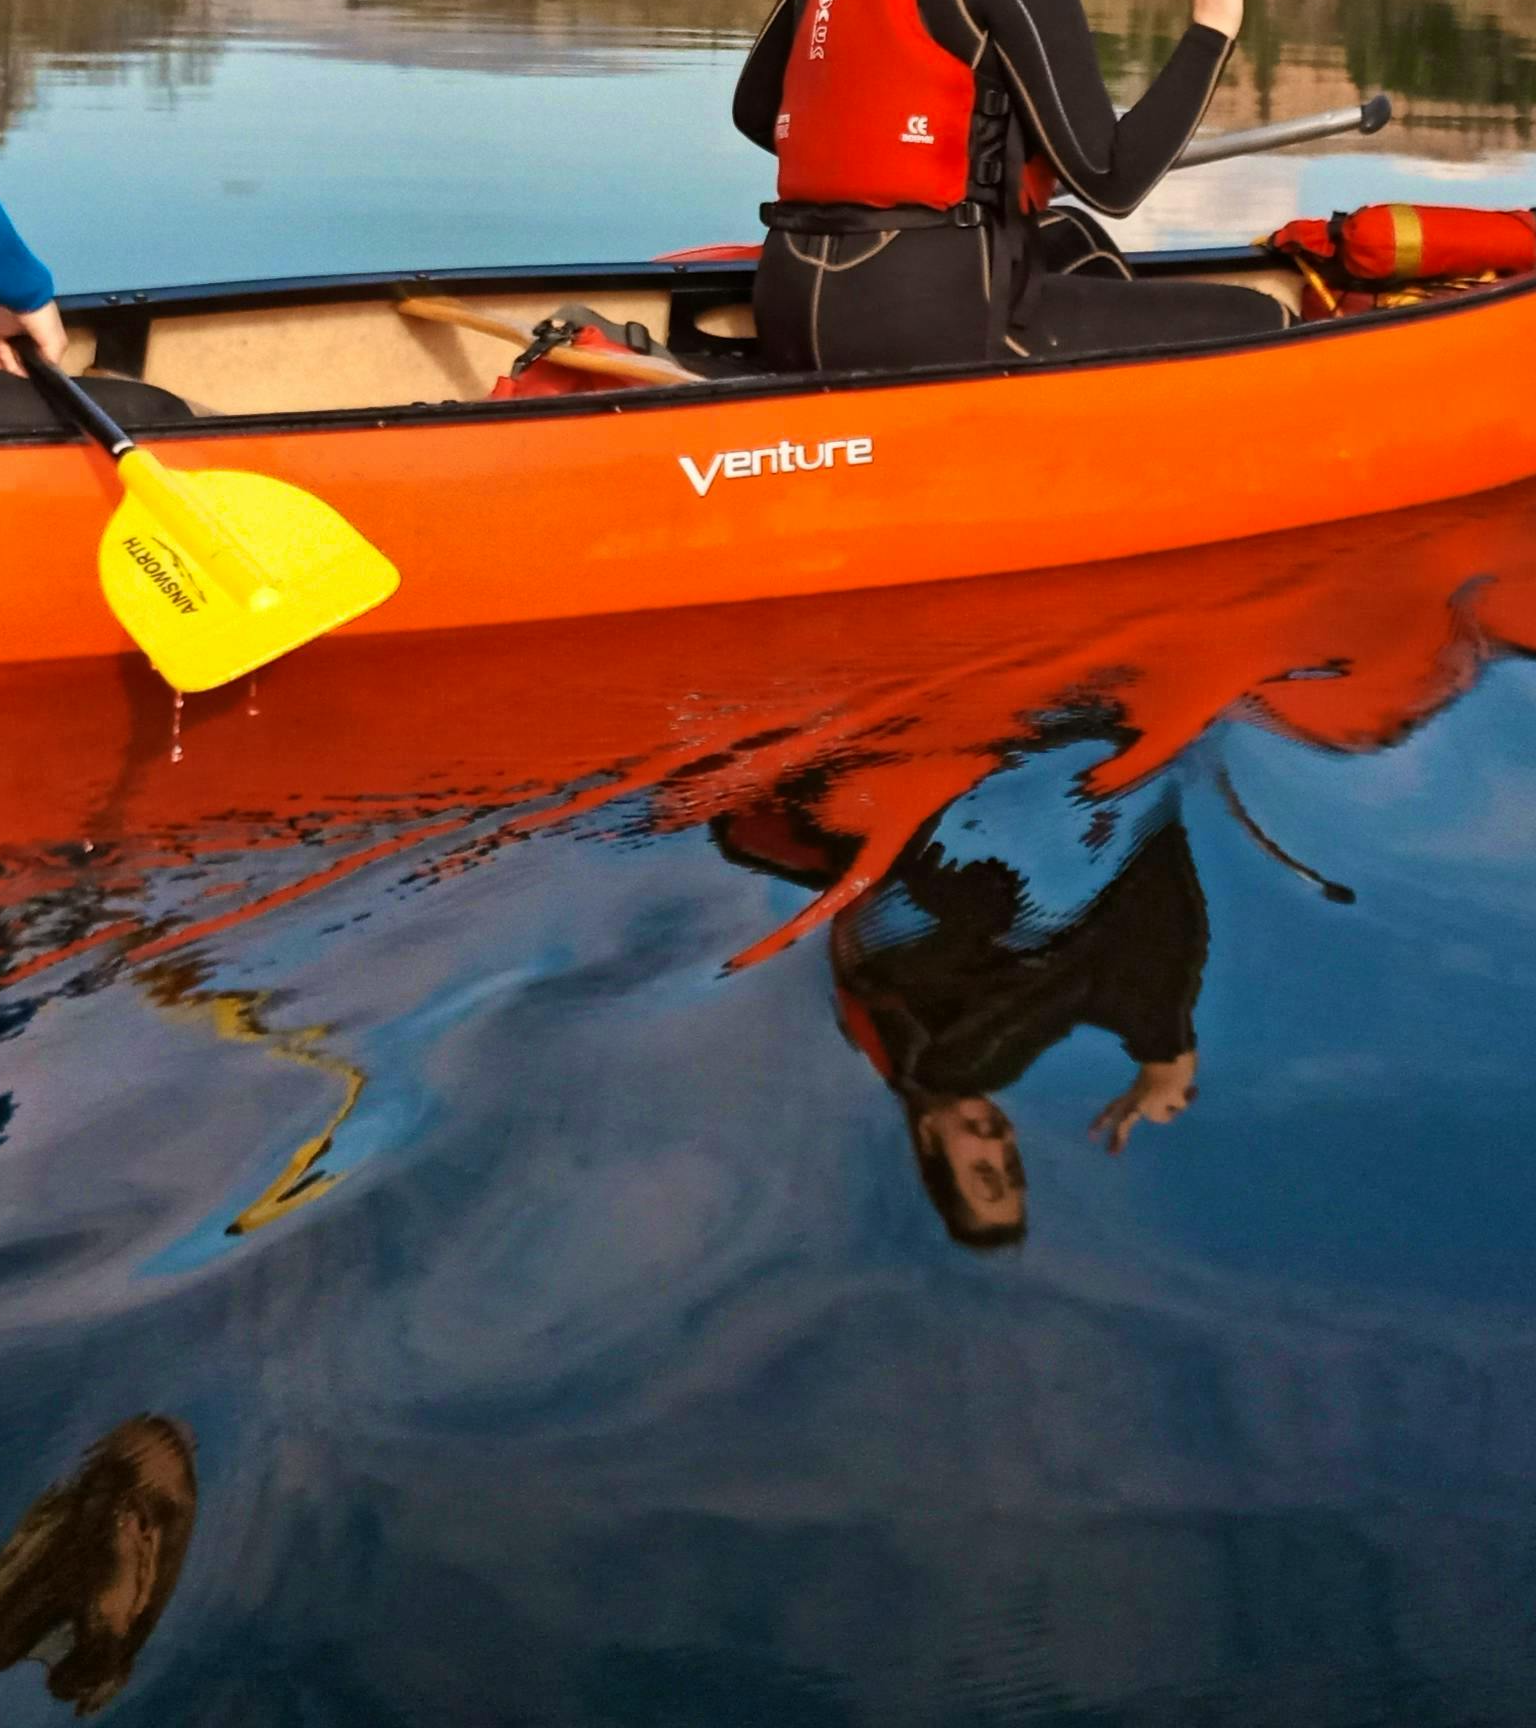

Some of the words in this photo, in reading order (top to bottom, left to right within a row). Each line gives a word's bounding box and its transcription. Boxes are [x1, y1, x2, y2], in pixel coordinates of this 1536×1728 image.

[907, 115, 929, 136] CE
[677, 437, 874, 498] Venture
[122, 536, 199, 615] AINSWORTH
